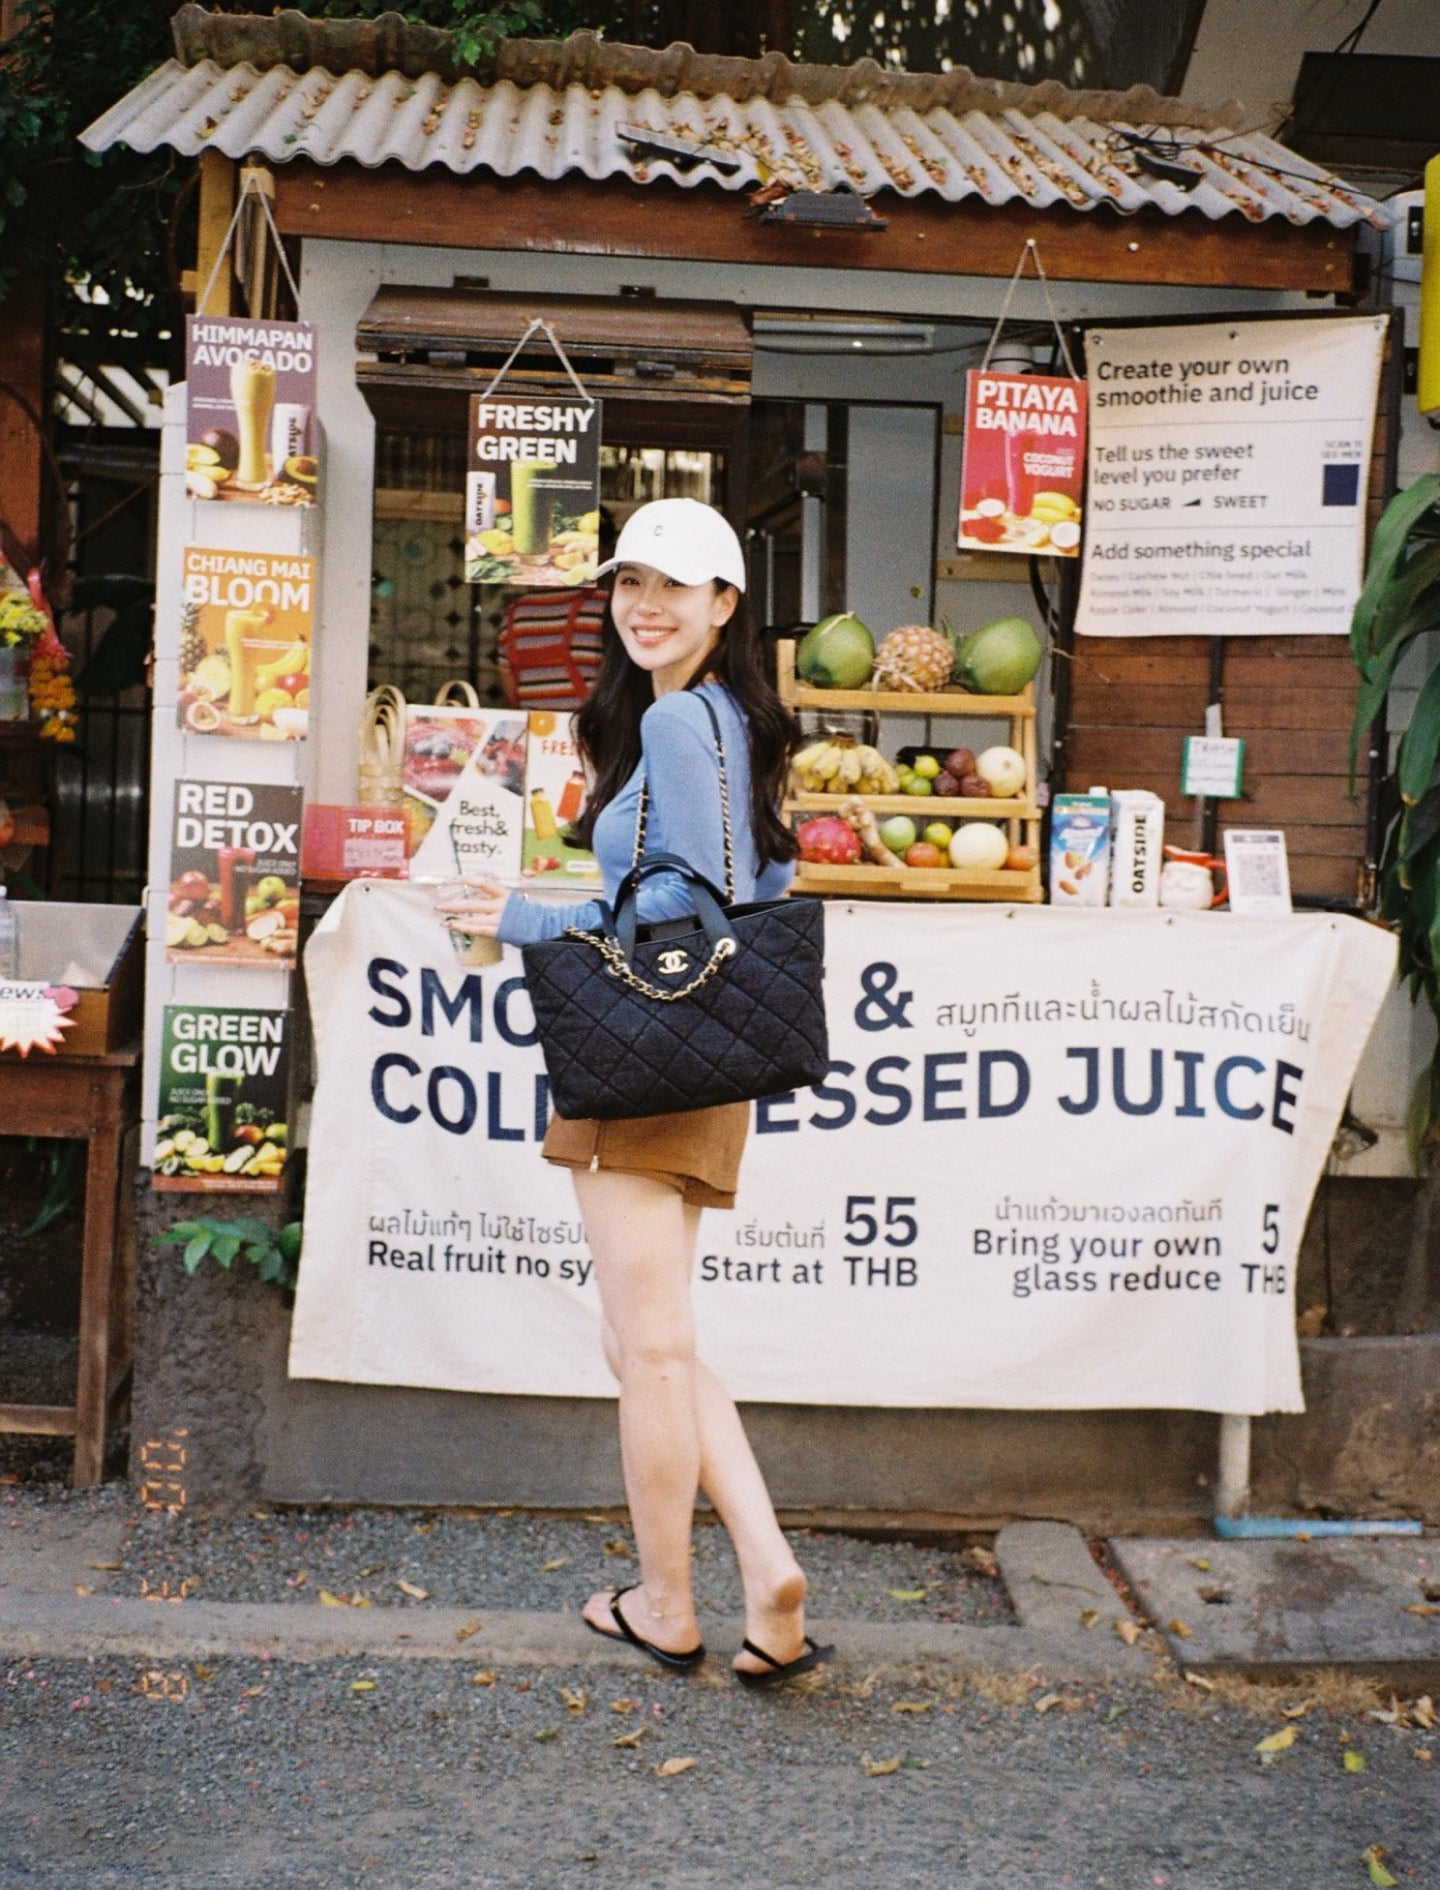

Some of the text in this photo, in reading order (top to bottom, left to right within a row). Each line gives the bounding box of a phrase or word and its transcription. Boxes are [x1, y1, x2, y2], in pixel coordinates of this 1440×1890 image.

[192, 324, 313, 350] HIMMAPAN
[193, 345, 313, 373] AVOCADO
[1096, 358, 1290, 382] Create your own
[977, 379, 1079, 414] PITAYA
[1096, 380, 1319, 407] smoothie and juice
[478, 404, 595, 432] FRESHY
[975, 407, 1078, 437] BANANA
[476, 435, 577, 464] GREEN
[1095, 443, 1254, 463] Tell us the sweet
[1093, 464, 1241, 486] level you prefer
[1092, 495, 1268, 512] NO SUGAR SWEET
[653, 524, 664, 537] C
[187, 552, 311, 580] CHIANG MAI
[1091, 540, 1312, 562] Add something special
[184, 574, 311, 612] BLOOM
[178, 783, 254, 817] RED
[176, 817, 299, 854] DETOX
[347, 818, 405, 834] TIP BOX
[450, 817, 509, 836] fresh&
[1132, 815, 1147, 893] OATSIDE
[367, 957, 915, 1048] SMO &
[171, 1012, 283, 1043] GREEN
[170, 1043, 282, 1076] GLOW
[756, 1047, 1304, 1135] ESSED JUICE
[843, 1196, 919, 1247] 55
[1262, 1204, 1280, 1254] 5
[973, 1229, 1222, 1265] Bring your own
[368, 1240, 593, 1287] Real fruit no sy
[701, 1255, 824, 1285] Start at
[843, 1256, 919, 1287] THB
[1240, 1262, 1286, 1295] THB
[1012, 1263, 1222, 1298] glass reduce
